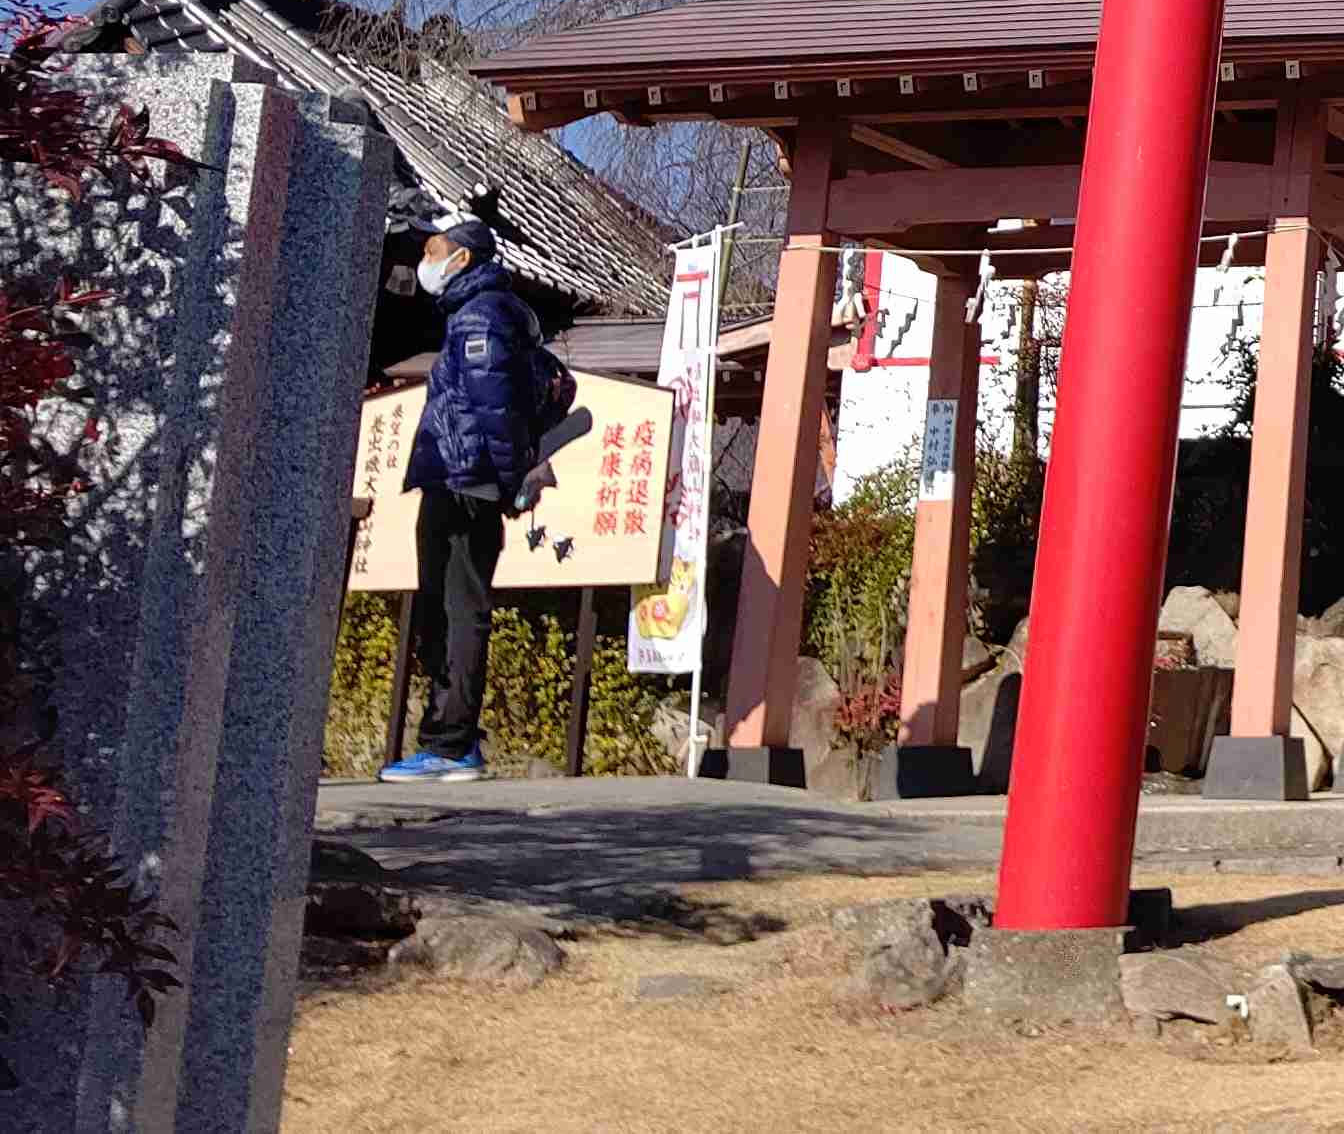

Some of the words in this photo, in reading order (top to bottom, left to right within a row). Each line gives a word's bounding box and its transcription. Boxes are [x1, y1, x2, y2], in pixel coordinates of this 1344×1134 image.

[593, 421, 625, 537] 健康祈願
[623, 418, 656, 535] 疫病退散
